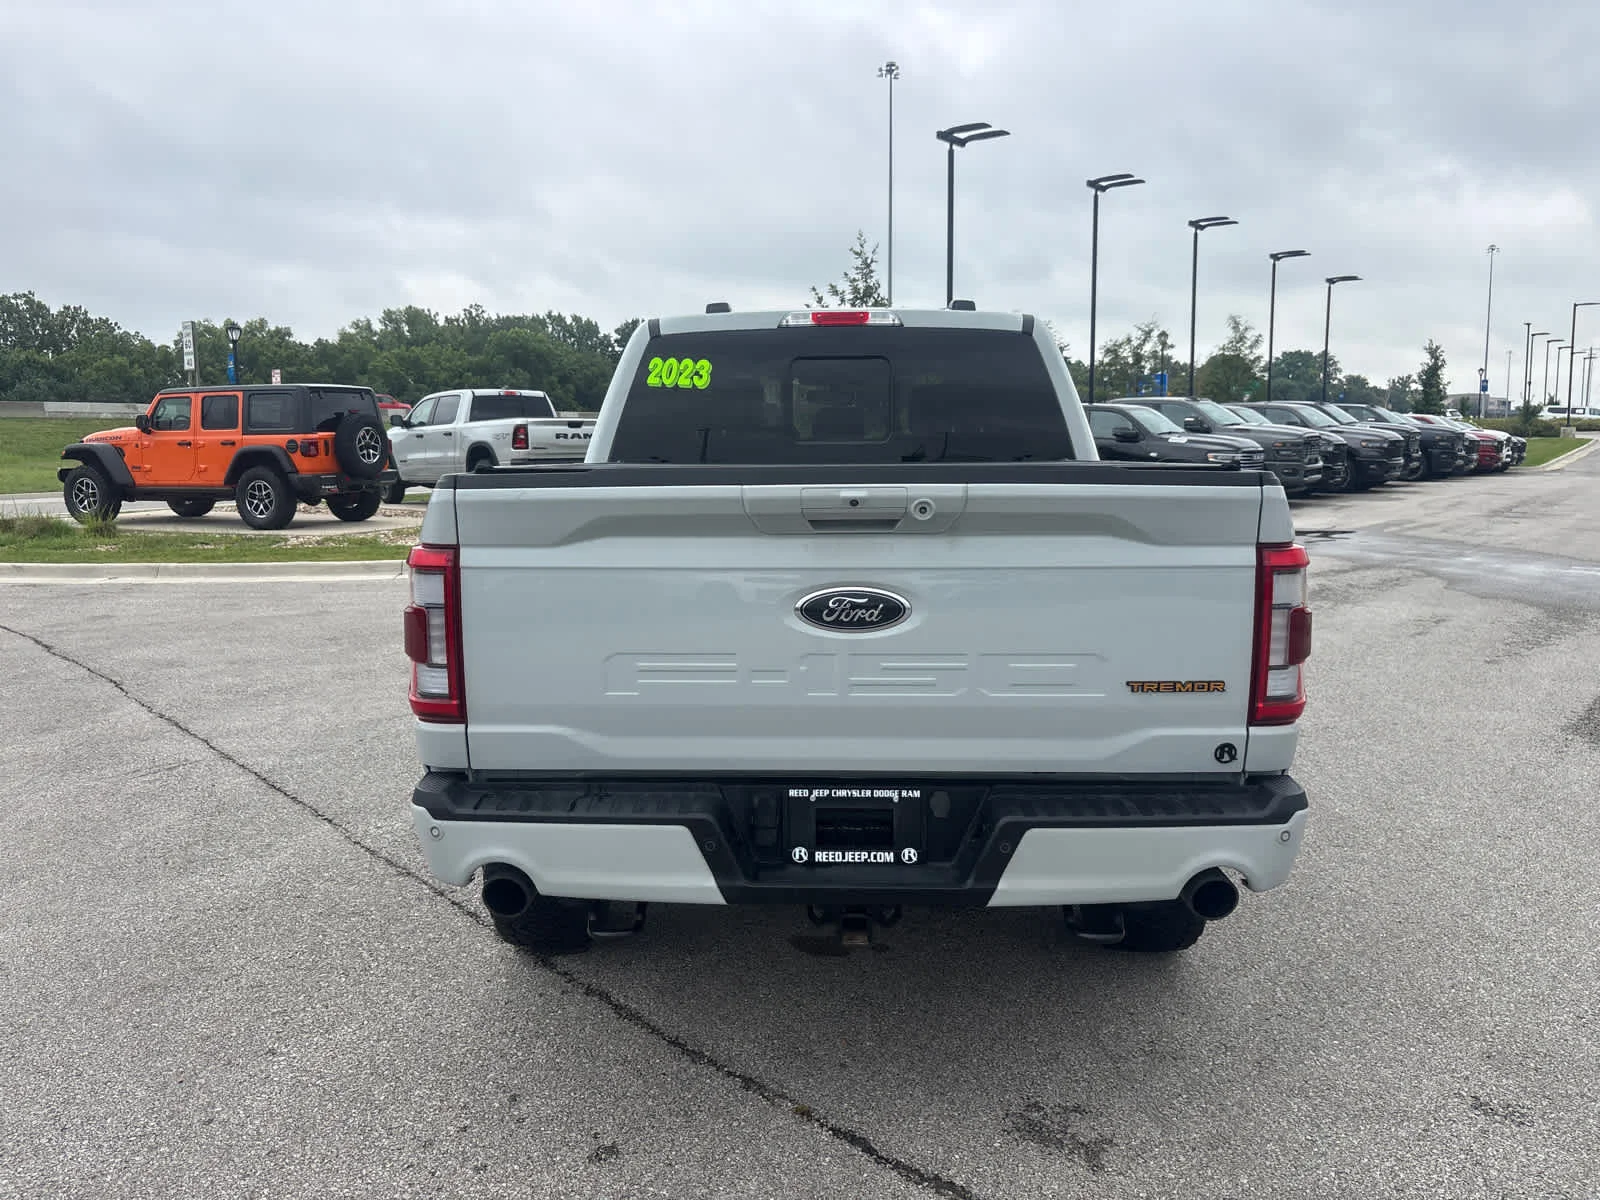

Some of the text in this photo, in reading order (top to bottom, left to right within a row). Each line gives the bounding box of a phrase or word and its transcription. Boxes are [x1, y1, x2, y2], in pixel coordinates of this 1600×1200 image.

[647, 357, 712, 389] 2023
[822, 596, 884, 622] Ford
[1126, 681, 1226, 692] TREMOR
[789, 789, 921, 799] REED JEEP CHRYSLER DODGE RAM
[815, 851, 895, 863] REEDJEEP.COM
